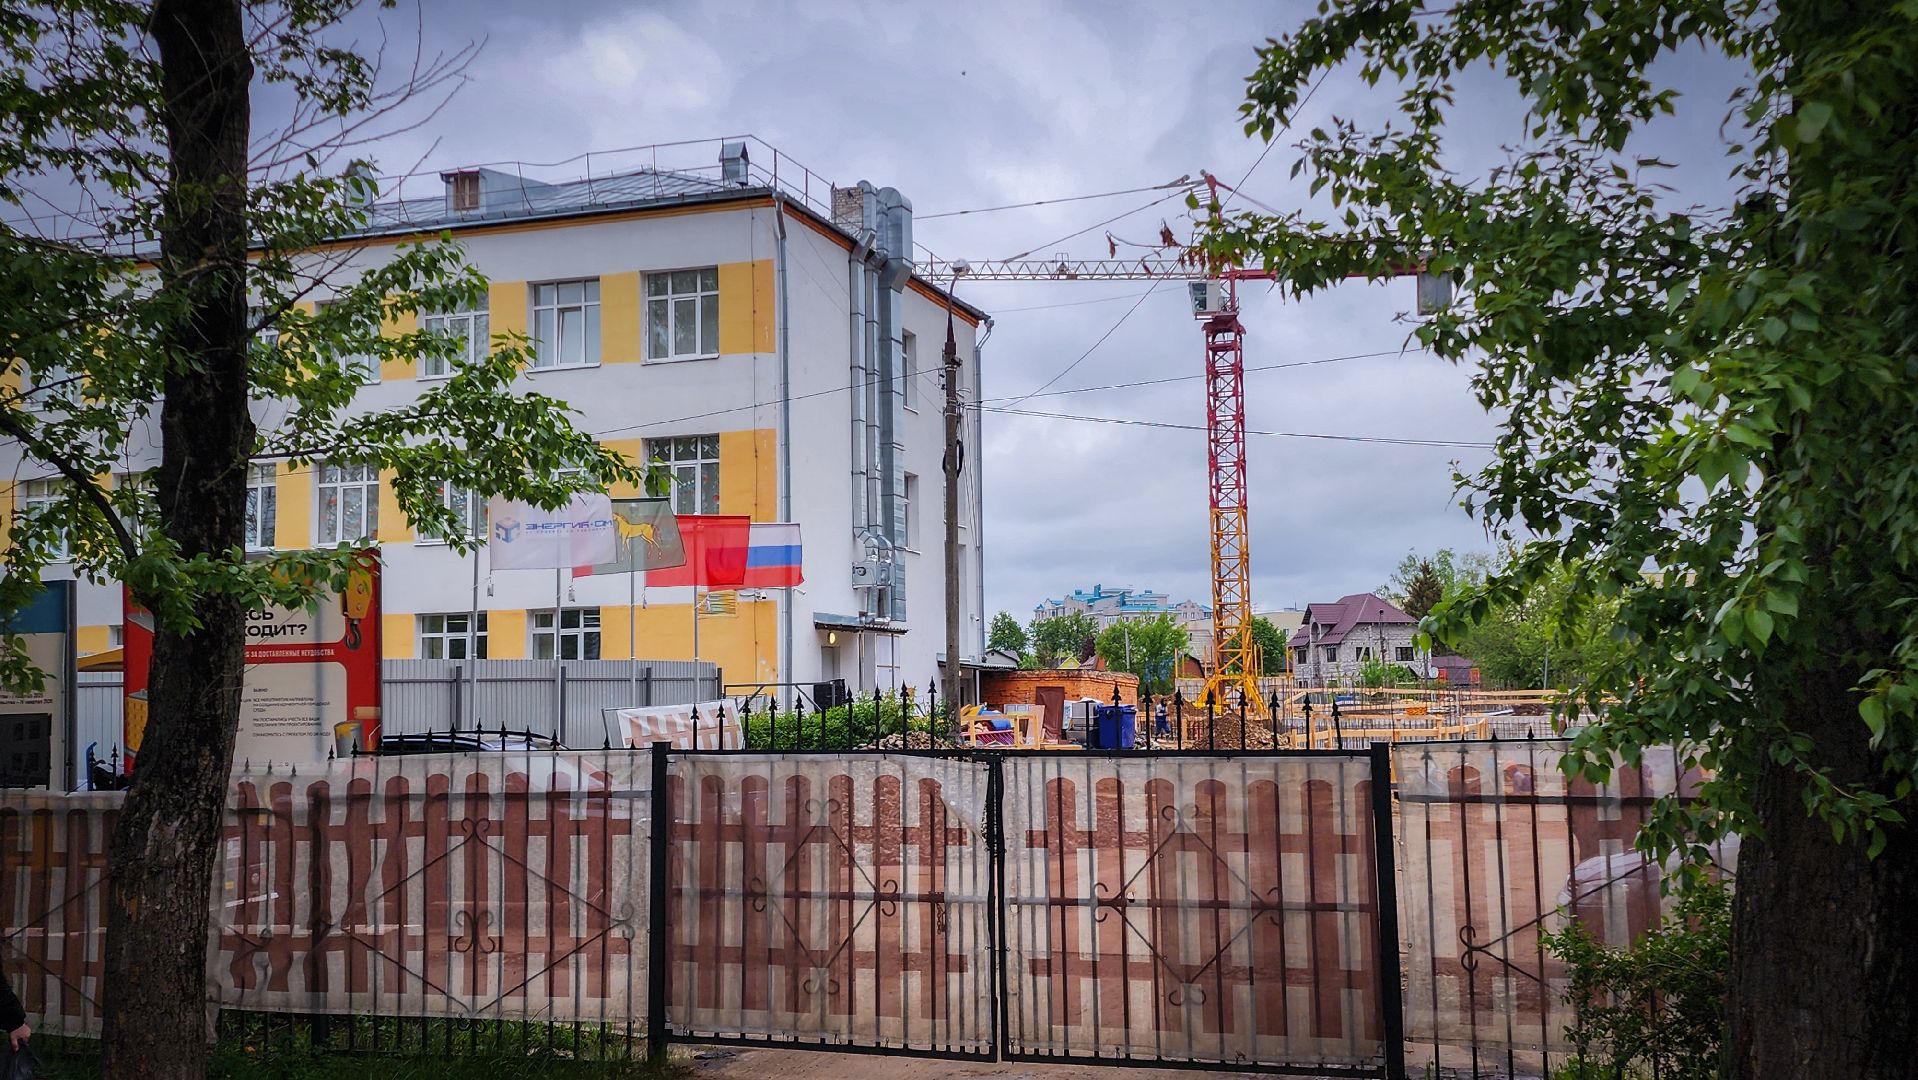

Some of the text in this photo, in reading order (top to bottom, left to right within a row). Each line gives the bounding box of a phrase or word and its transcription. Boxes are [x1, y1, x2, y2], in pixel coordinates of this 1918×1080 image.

[245, 609, 274, 621] СЬ
[258, 649, 300, 658] ДОСТАВЛЕННЫЕ
[301, 648, 335, 657] НЕУДОБСТВА
